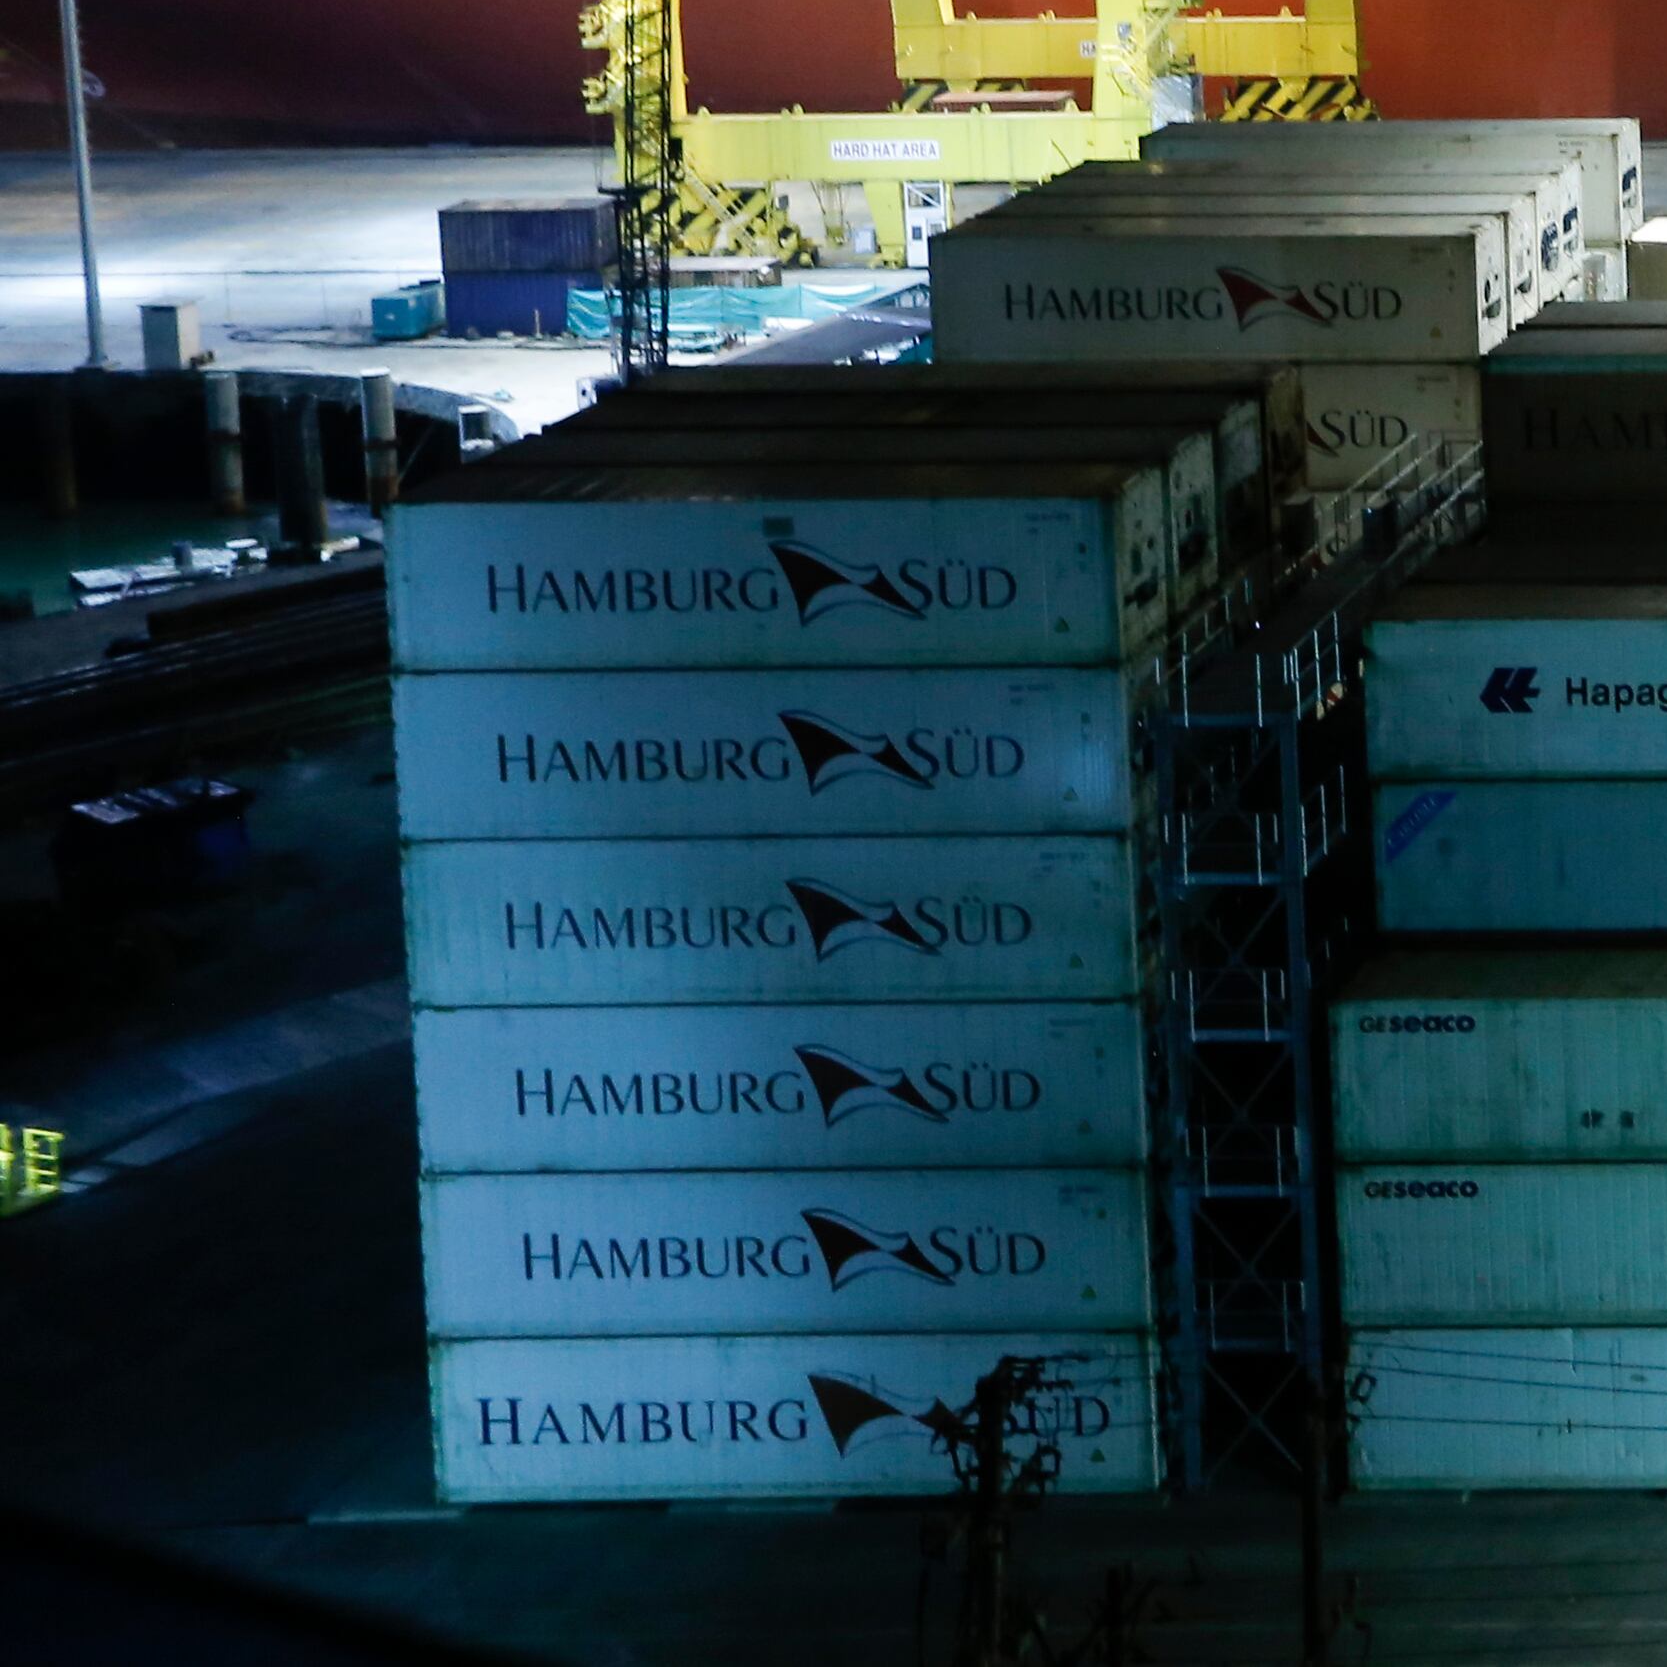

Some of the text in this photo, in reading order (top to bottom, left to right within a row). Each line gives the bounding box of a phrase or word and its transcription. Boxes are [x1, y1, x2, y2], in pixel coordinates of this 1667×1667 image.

[834, 143, 936, 157] HARD HAT AREA
[1005, 280, 1402, 322] HAMBURG SÜD
[1321, 409, 1407, 448] SÜD
[487, 559, 1016, 614] HAMBURG SÜD
[498, 728, 1025, 782] HAMBURG SÜD
[505, 897, 1032, 949] HAMBURG SÜD
[515, 1063, 1041, 1116] HAMBURG SÜD
[522, 1226, 1046, 1280] HAMBURG SÜD
[478, 1396, 807, 1446] HAMBURG
